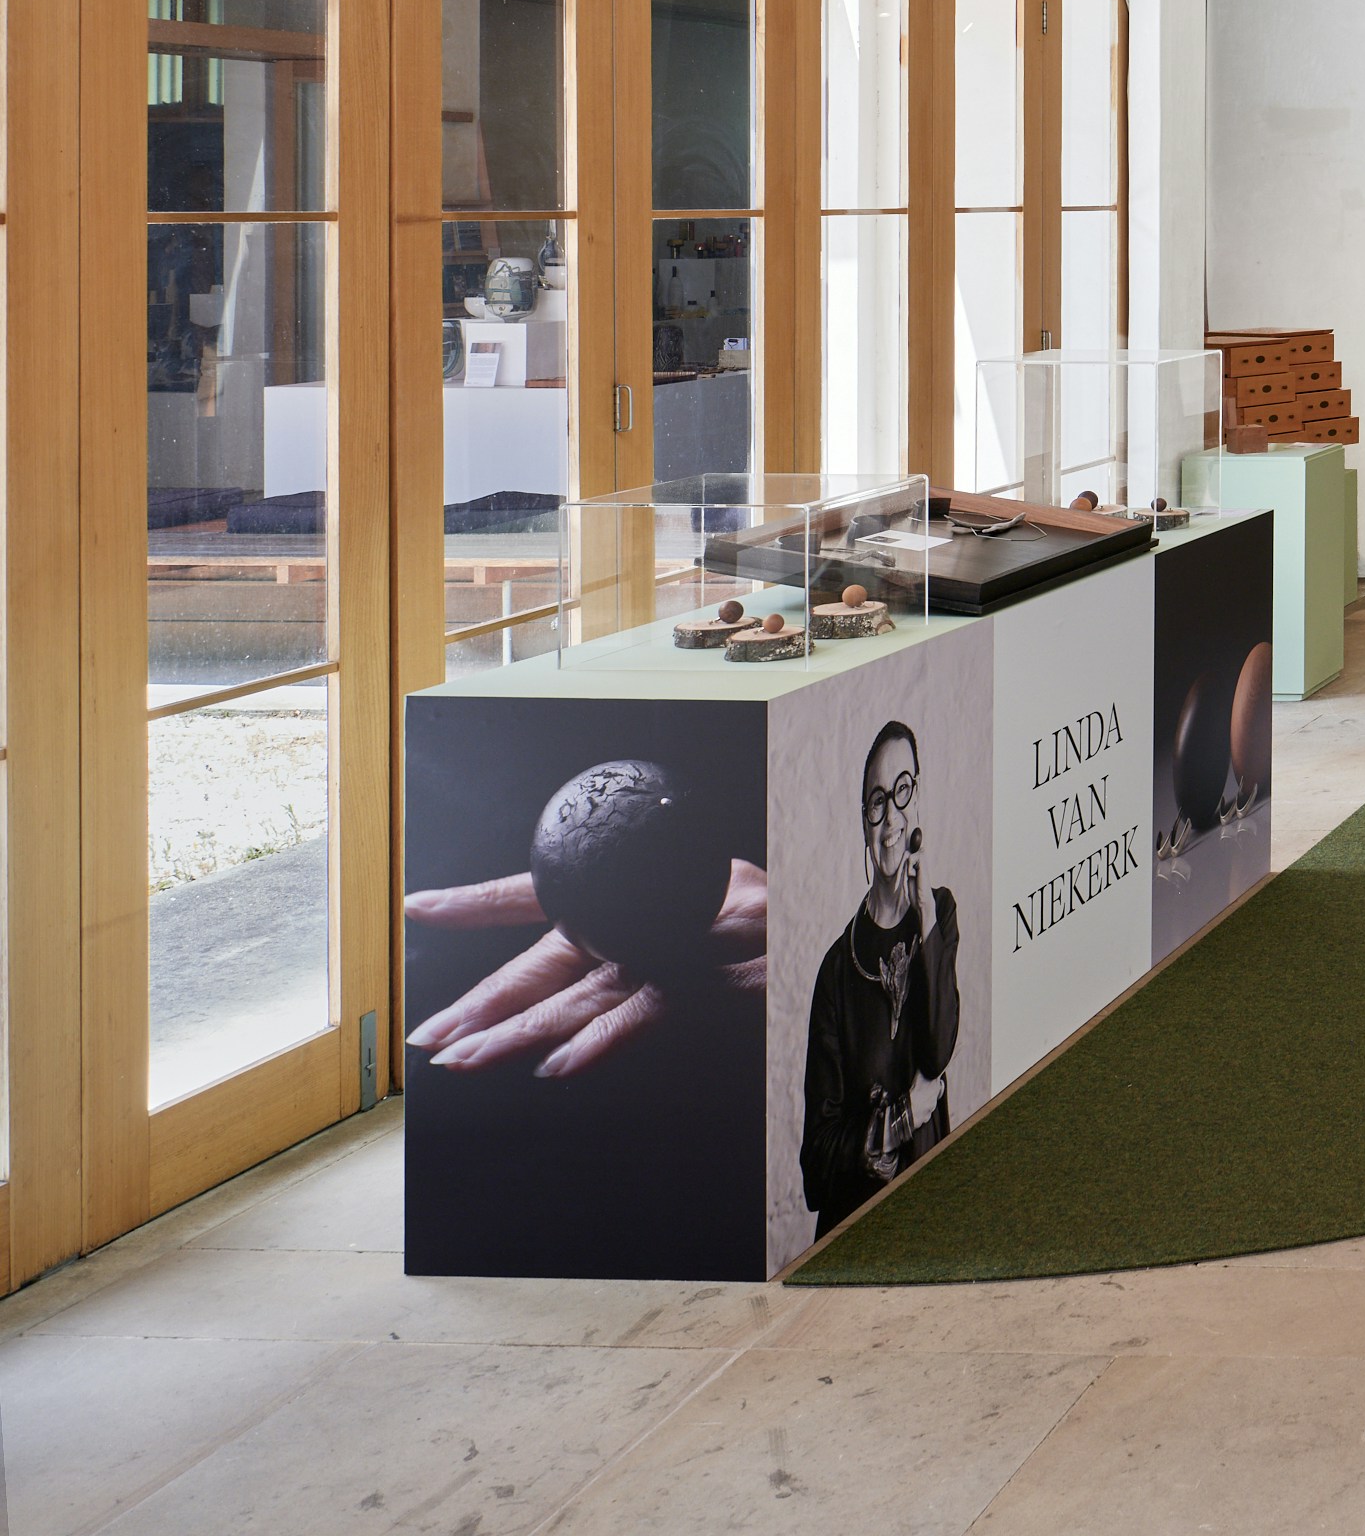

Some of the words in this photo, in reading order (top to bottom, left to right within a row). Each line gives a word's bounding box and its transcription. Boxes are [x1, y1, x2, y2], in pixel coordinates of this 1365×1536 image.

[1032, 702, 1124, 790] LINDA
[1047, 774, 1109, 850] VAN
[1012, 825, 1139, 953] NIEKERK
